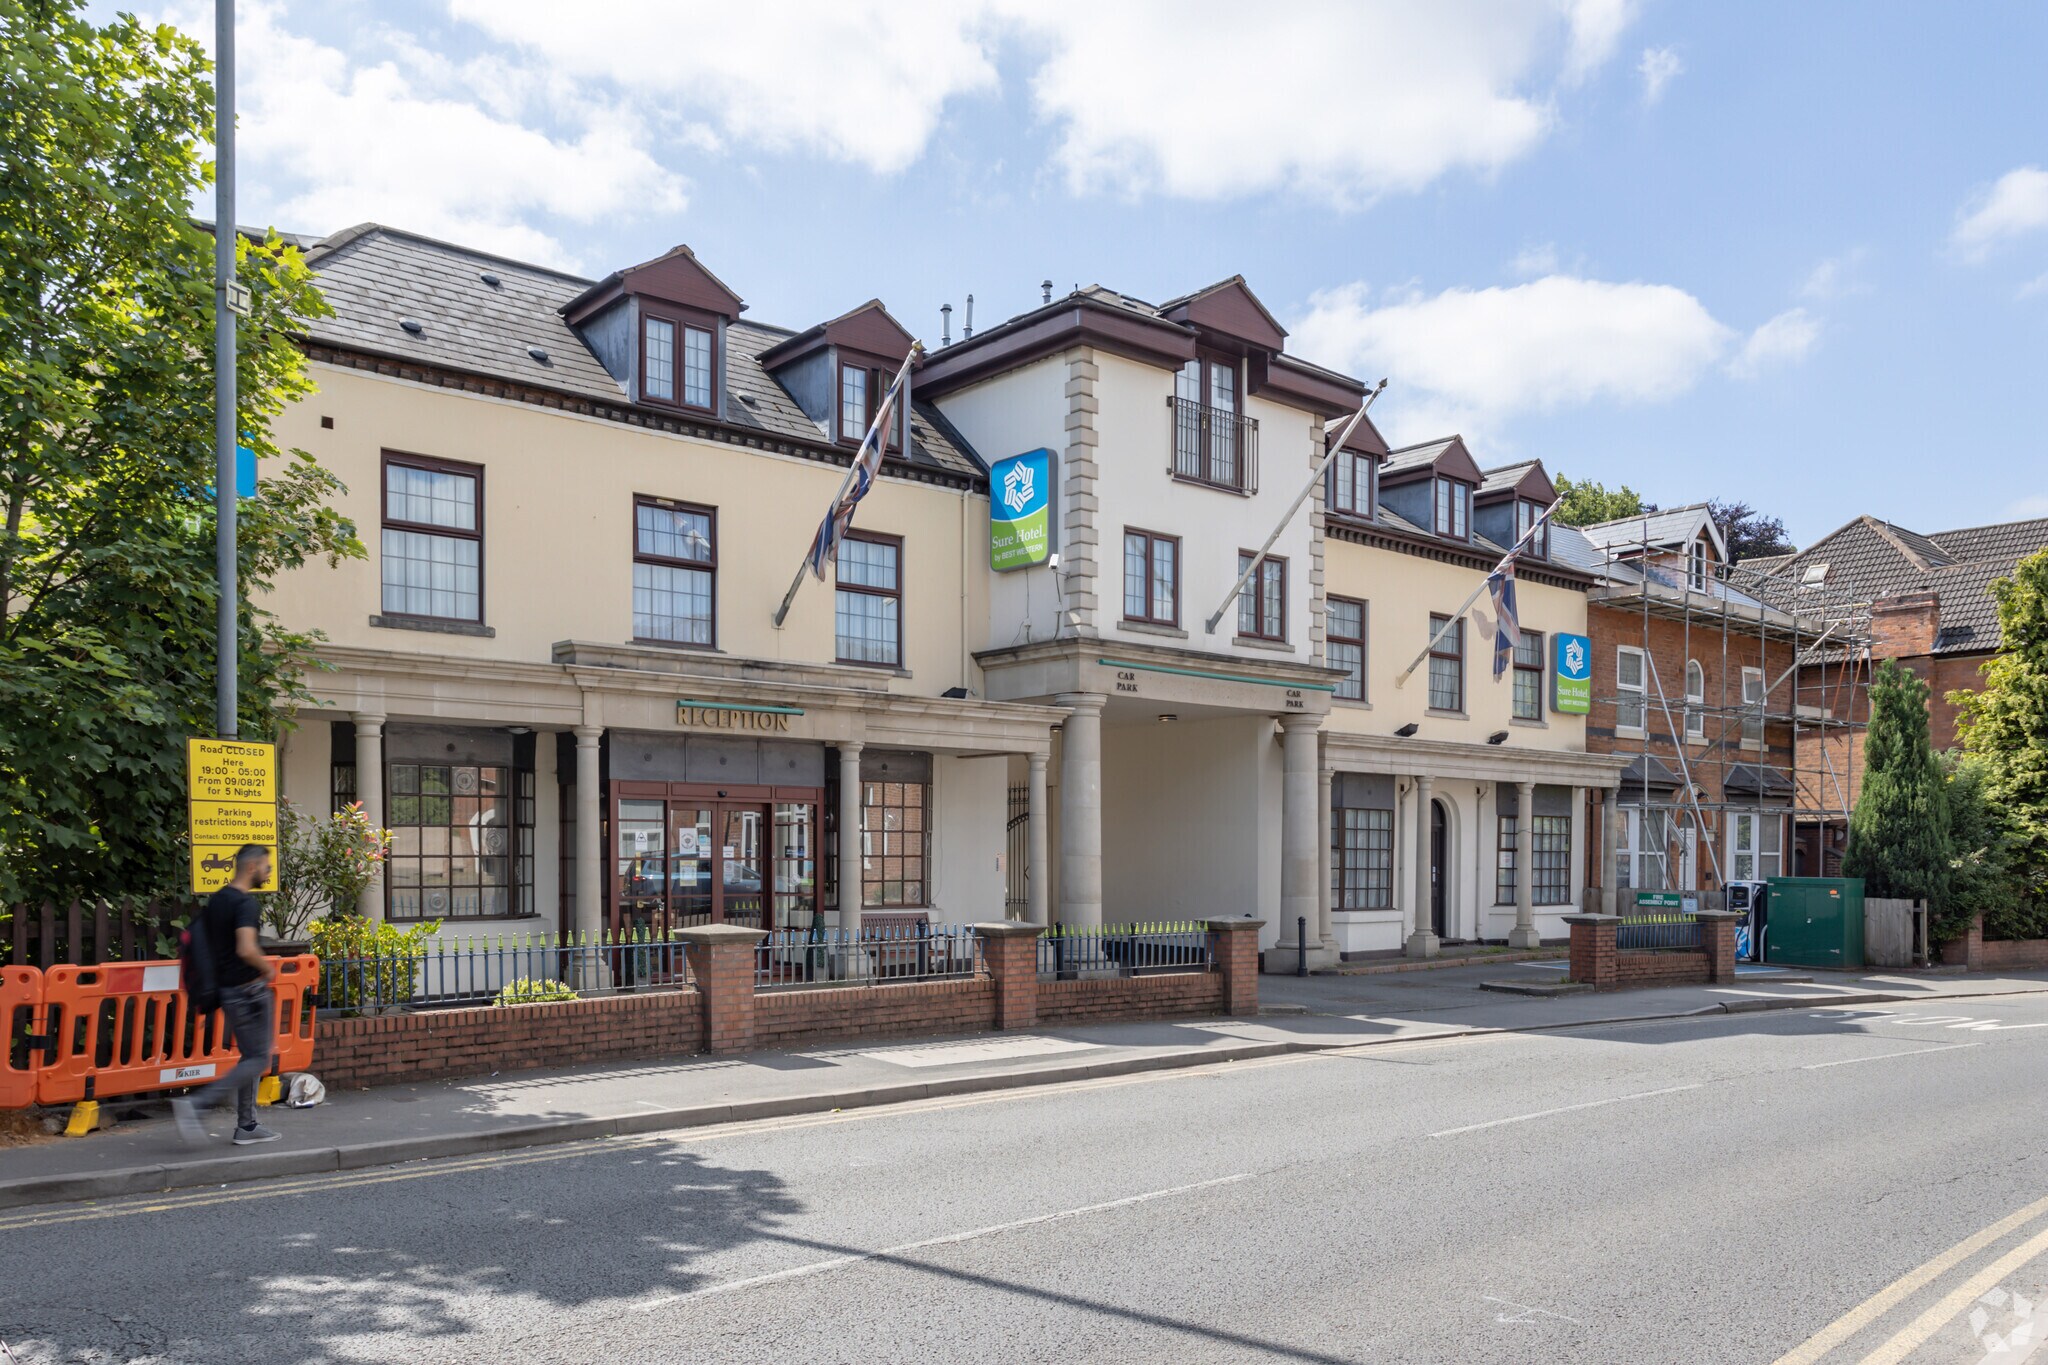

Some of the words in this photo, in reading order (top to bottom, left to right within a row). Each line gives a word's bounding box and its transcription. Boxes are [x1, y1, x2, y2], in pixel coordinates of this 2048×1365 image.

[992, 536, 1014, 549] Sure
[1016, 524, 1043, 543] Hotel
[1117, 671, 1135, 681] CAR
[1116, 682, 1138, 692] PARK
[1286, 689, 1302, 698] CAR
[1286, 700, 1304, 708] PARK
[676, 704, 790, 731] RECEPTION
[200, 744, 223, 754] Road
[226, 746, 265, 757] CLOSED
[222, 758, 244, 766] Here
[202, 766, 228, 775] 19:00
[238, 768, 266, 777] 05:00
[198, 776, 221, 785] From
[224, 777, 265, 787] 09/08/21
[207, 786, 221, 795] for
[225, 787, 231, 795] 5
[234, 788, 262, 797] Nights
[218, 808, 252, 818] Parking
[194, 818, 247, 827] restrictions
[250, 820, 274, 828] apply
[201, 877, 220, 885] Tow
